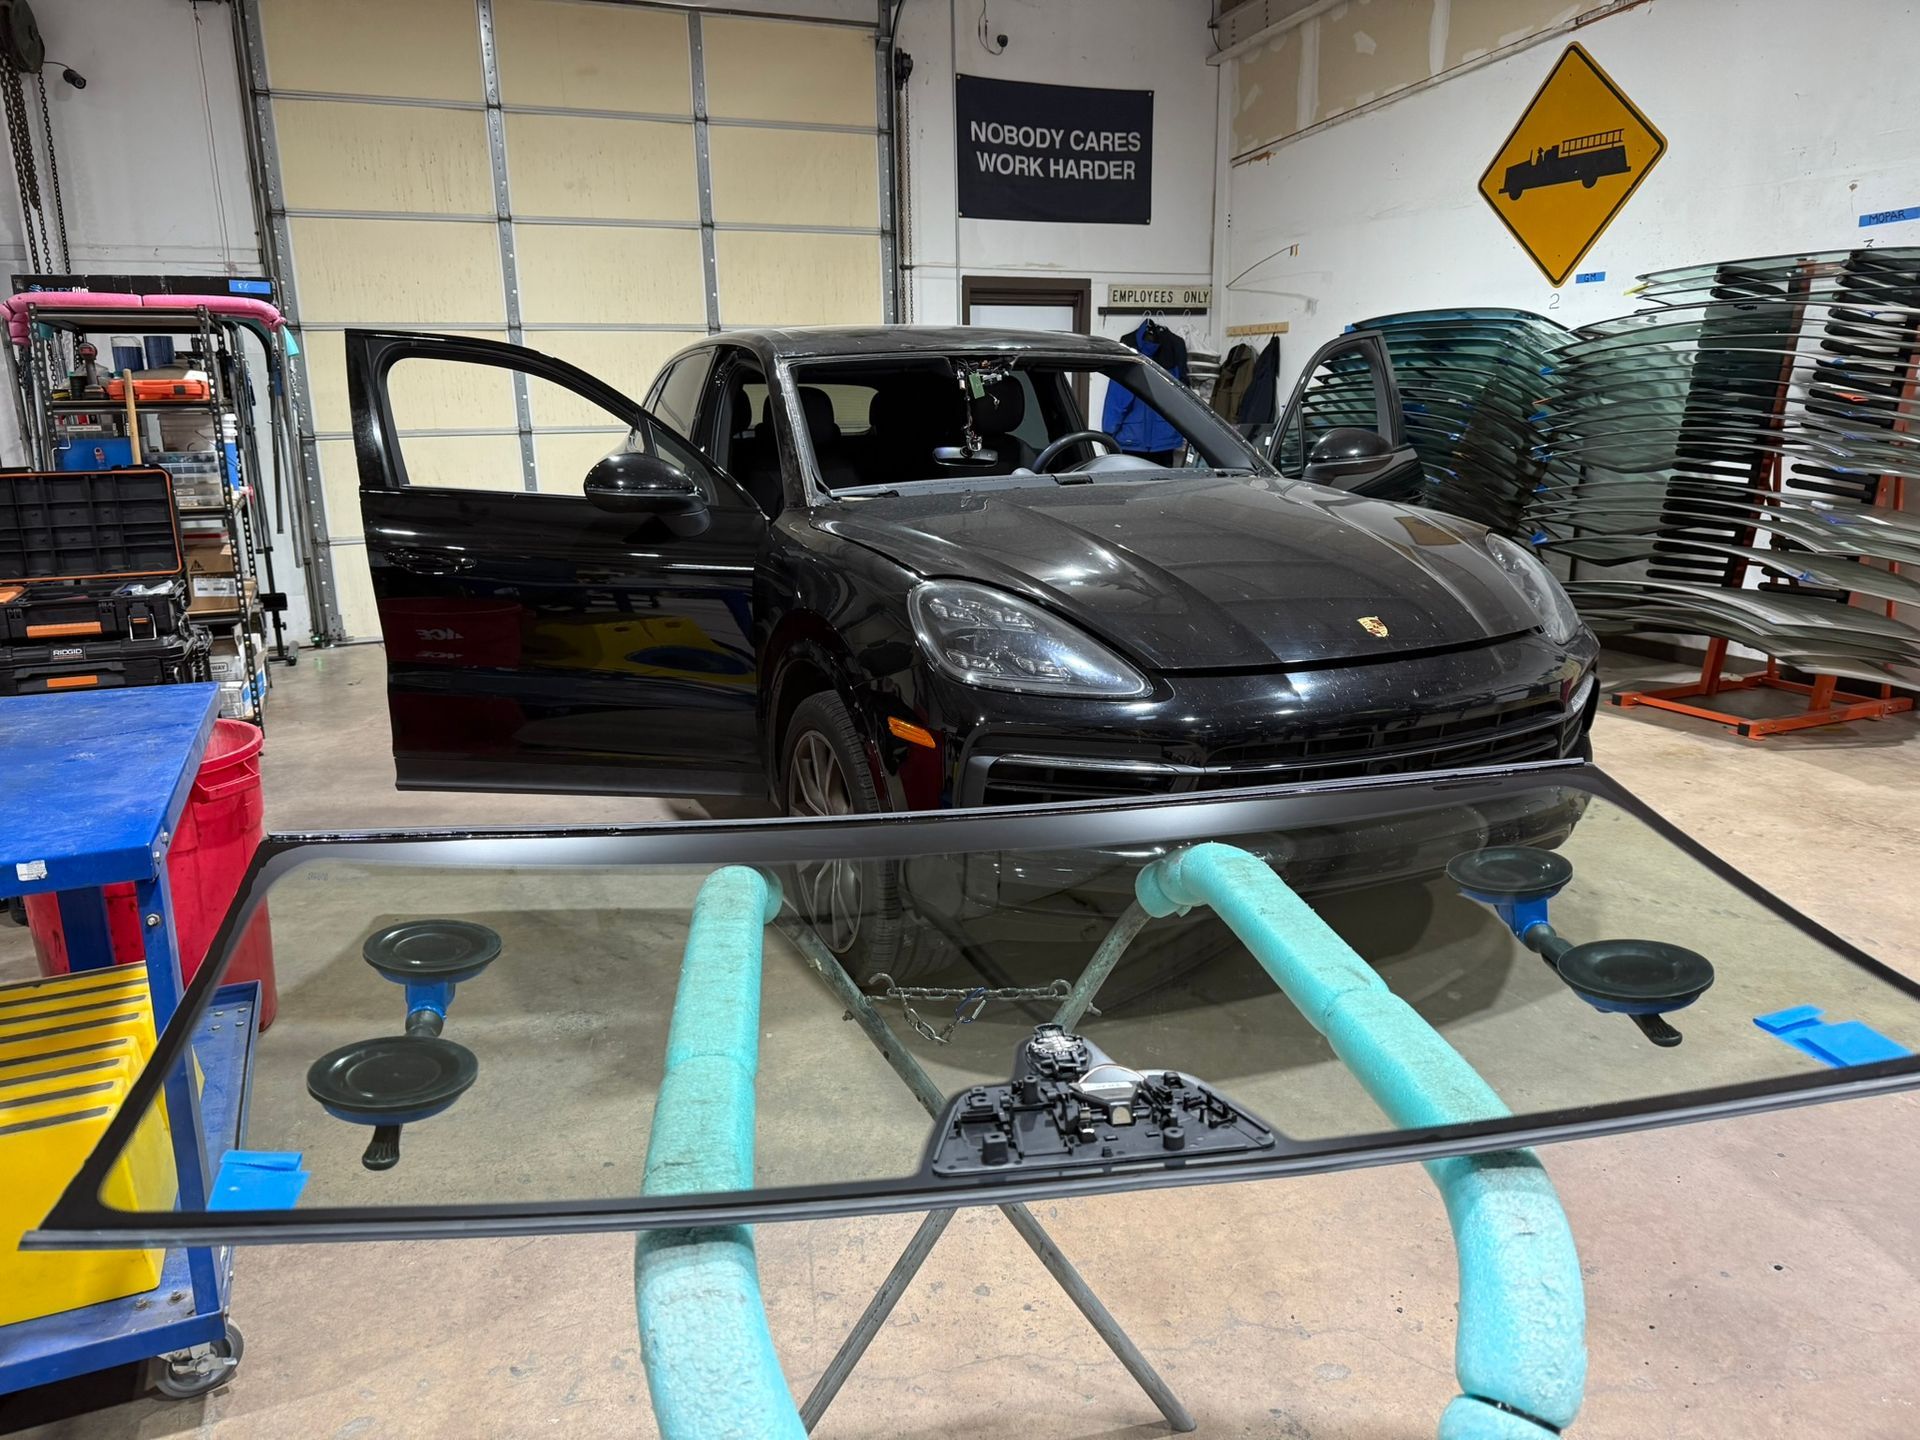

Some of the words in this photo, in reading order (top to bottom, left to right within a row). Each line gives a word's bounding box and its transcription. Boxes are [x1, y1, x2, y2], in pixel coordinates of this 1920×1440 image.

[970, 120, 1064, 149] NOBODY
[1069, 130, 1141, 152] CARES
[976, 151, 1044, 178] WORK
[1050, 158, 1136, 180] HARDER
[1868, 210, 1906, 226] MOPAR
[1584, 273, 1597, 283] GM
[1112, 290, 1173, 303] EMPLOYEES
[1184, 291, 1209, 304] ONLY
[1549, 293, 1560, 310] 2
[53, 648, 83, 656] RIDGID
